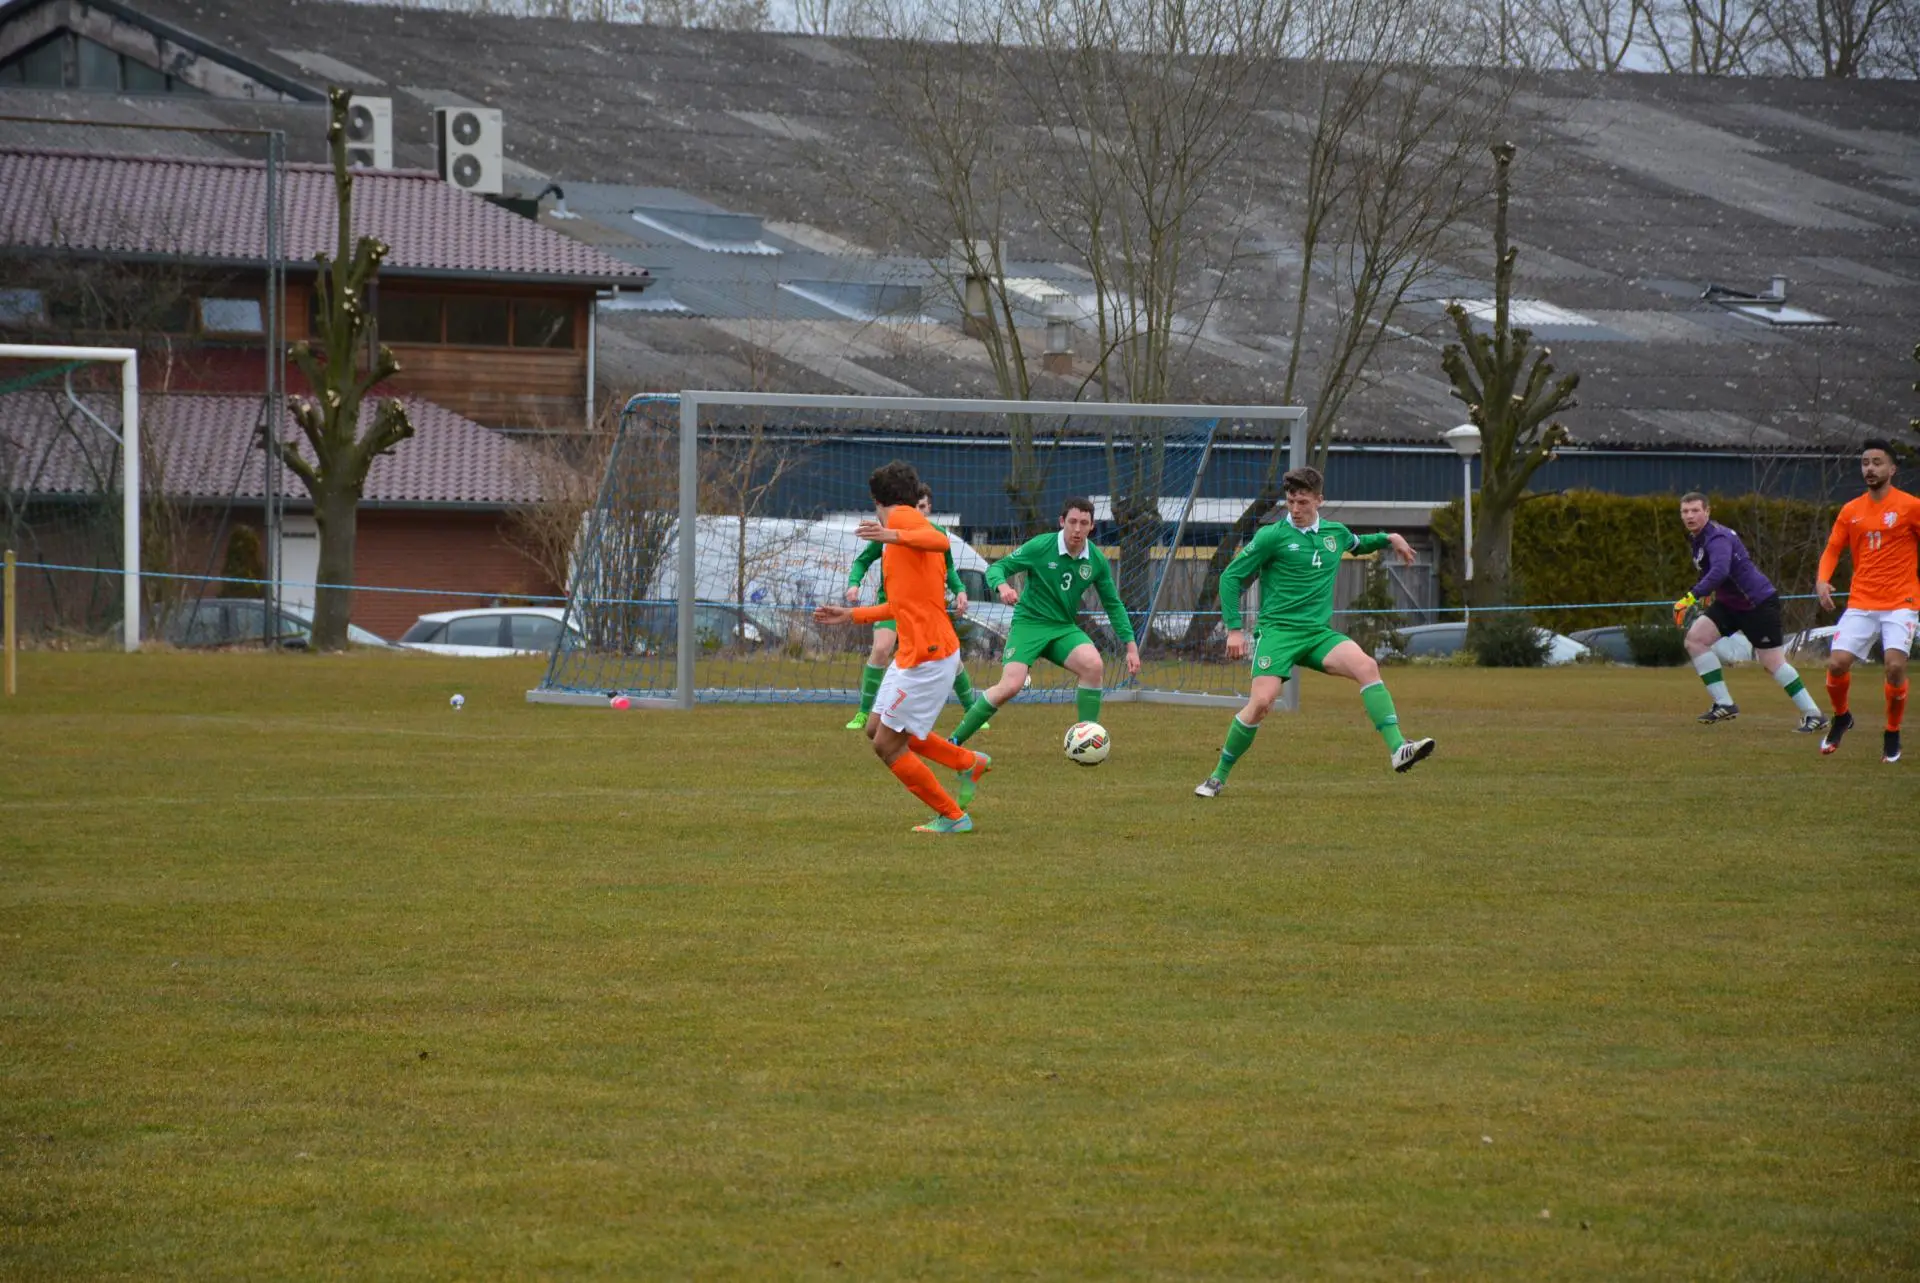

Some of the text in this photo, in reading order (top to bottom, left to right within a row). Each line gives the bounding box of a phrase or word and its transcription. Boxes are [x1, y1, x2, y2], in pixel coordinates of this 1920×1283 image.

[1866, 530, 1881, 551] 11
[1311, 549, 1322, 569] 4
[1060, 572, 1072, 591] 3
[890, 688, 907, 710] 7
